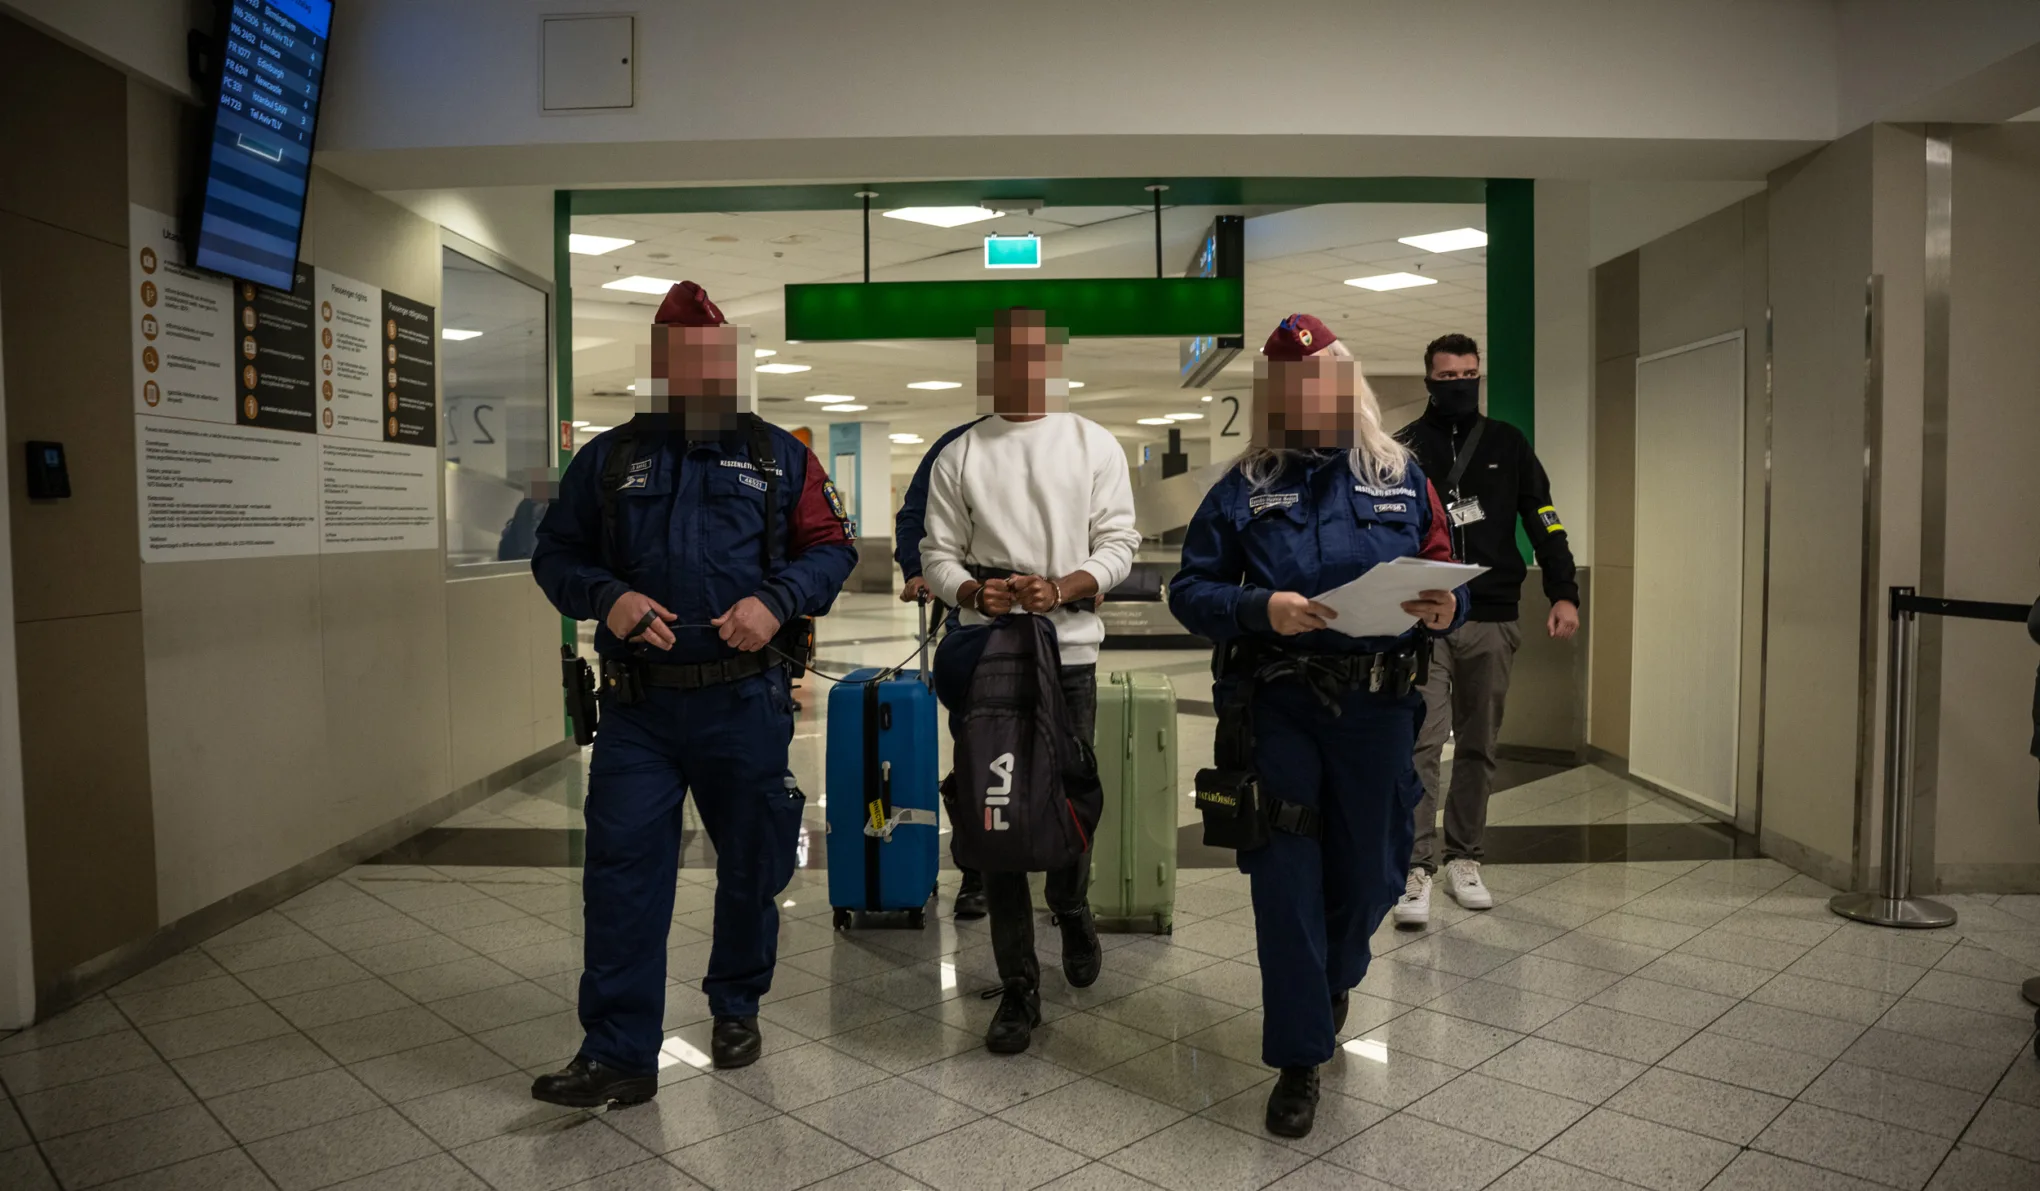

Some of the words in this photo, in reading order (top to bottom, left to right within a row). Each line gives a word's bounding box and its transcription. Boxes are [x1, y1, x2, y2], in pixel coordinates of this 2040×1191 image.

[262, 22, 272, 35] Tel
[265, 6, 296, 32] Birmingham
[260, 40, 281, 59] Larnaca
[228, 41, 238, 54] FR
[257, 57, 285, 79] Edinburgh
[255, 74, 283, 96] Newcastle
[252, 91, 274, 110] Istanbul
[250, 108, 260, 120] Tel
[1221, 395, 1240, 437] 2
[1456, 511, 1464, 522] V
[984, 752, 1015, 832] FILA
